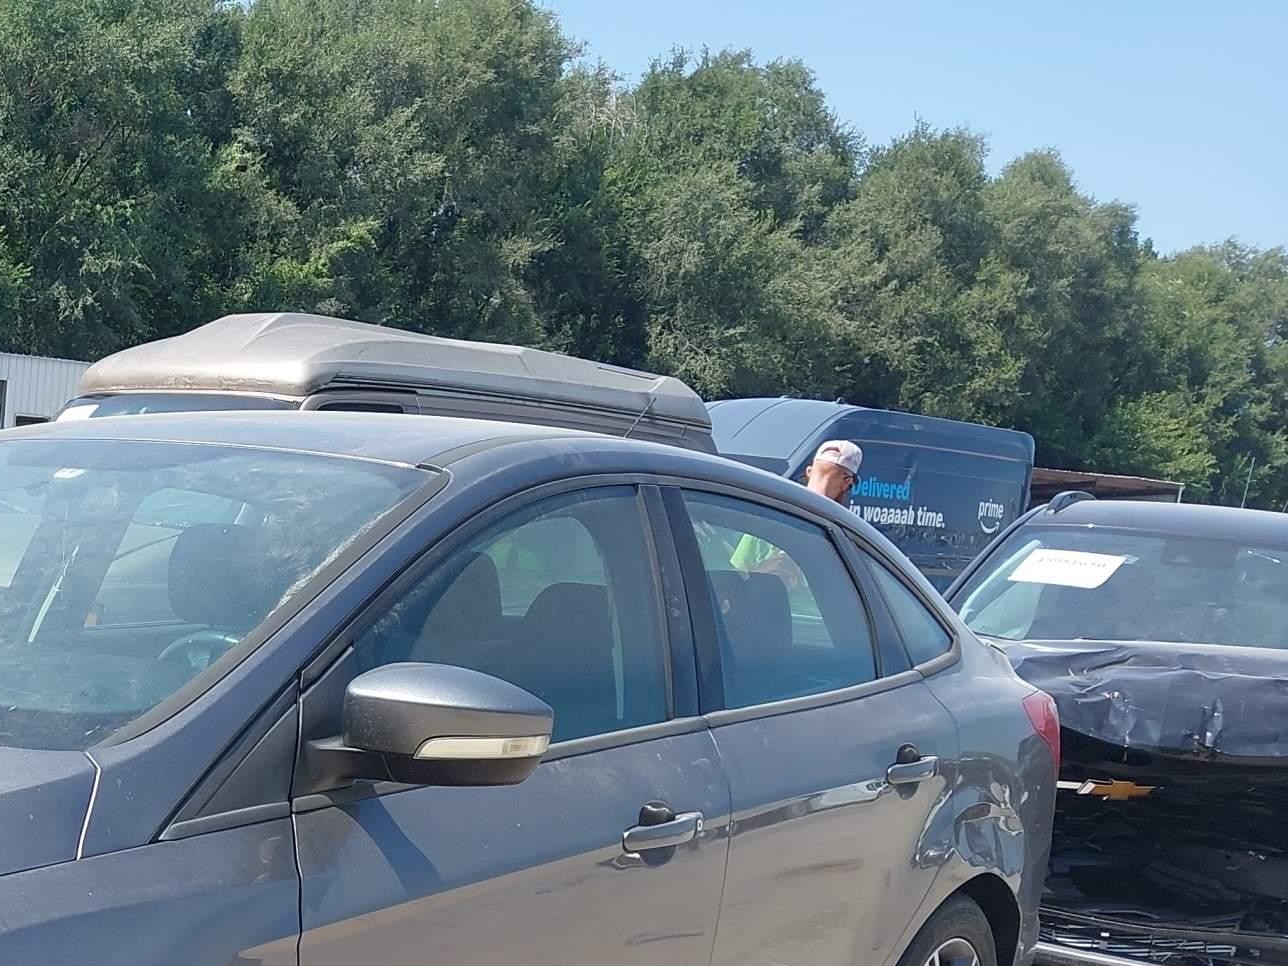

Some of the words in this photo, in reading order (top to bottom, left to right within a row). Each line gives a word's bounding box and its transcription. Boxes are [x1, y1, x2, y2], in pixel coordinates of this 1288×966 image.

[851, 475, 911, 500] Delivered
[863, 504, 915, 525] woaaaah
[916, 506, 945, 529] time.
[978, 498, 1004, 520] prime
